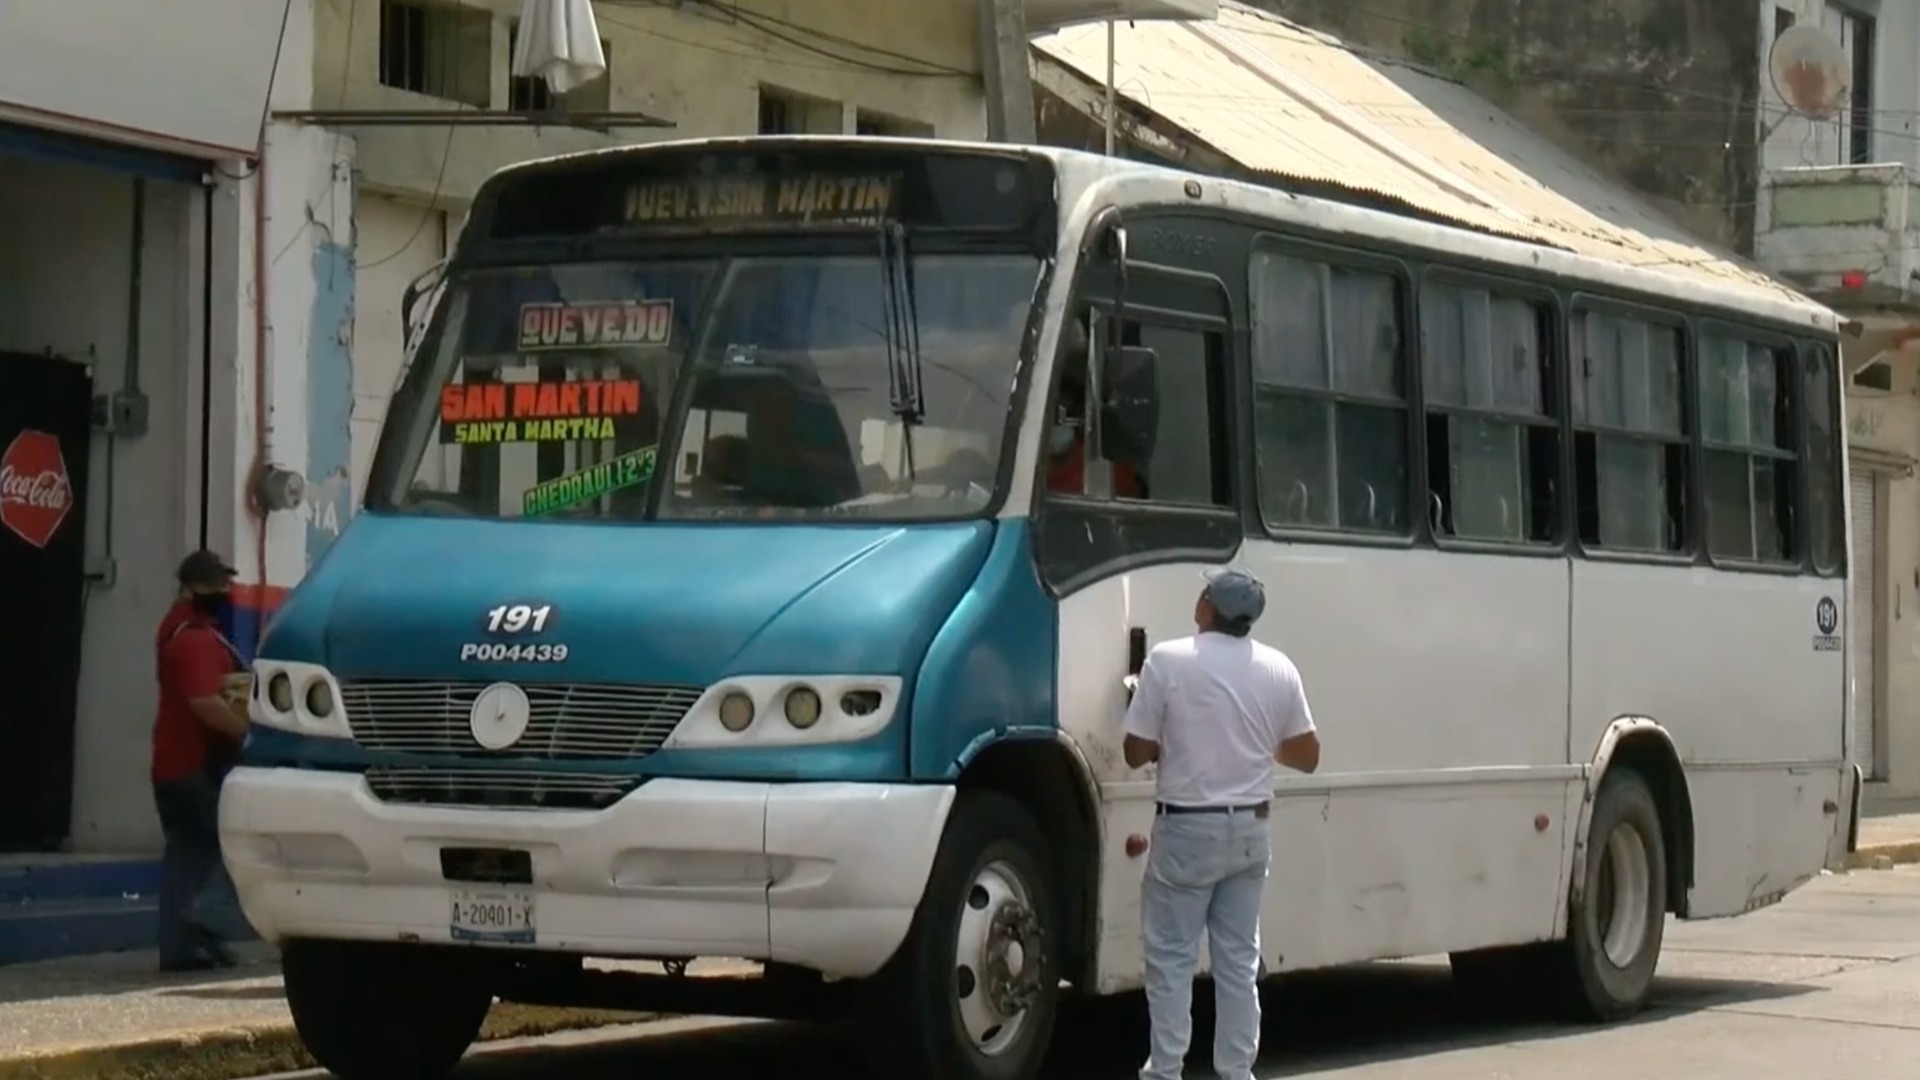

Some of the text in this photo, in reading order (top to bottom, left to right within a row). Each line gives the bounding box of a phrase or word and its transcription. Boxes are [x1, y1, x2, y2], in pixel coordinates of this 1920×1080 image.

[776, 176, 891, 213] MARTIN
[521, 304, 669, 345] QUEVEDO
[441, 379, 641, 421] SAN MARTIN
[455, 416, 616, 443] SANTA MARTHA
[488, 604, 552, 633] 191
[1818, 602, 1835, 628] 191
[460, 643, 568, 661] P004439
[452, 901, 533, 928] A-20401-X
